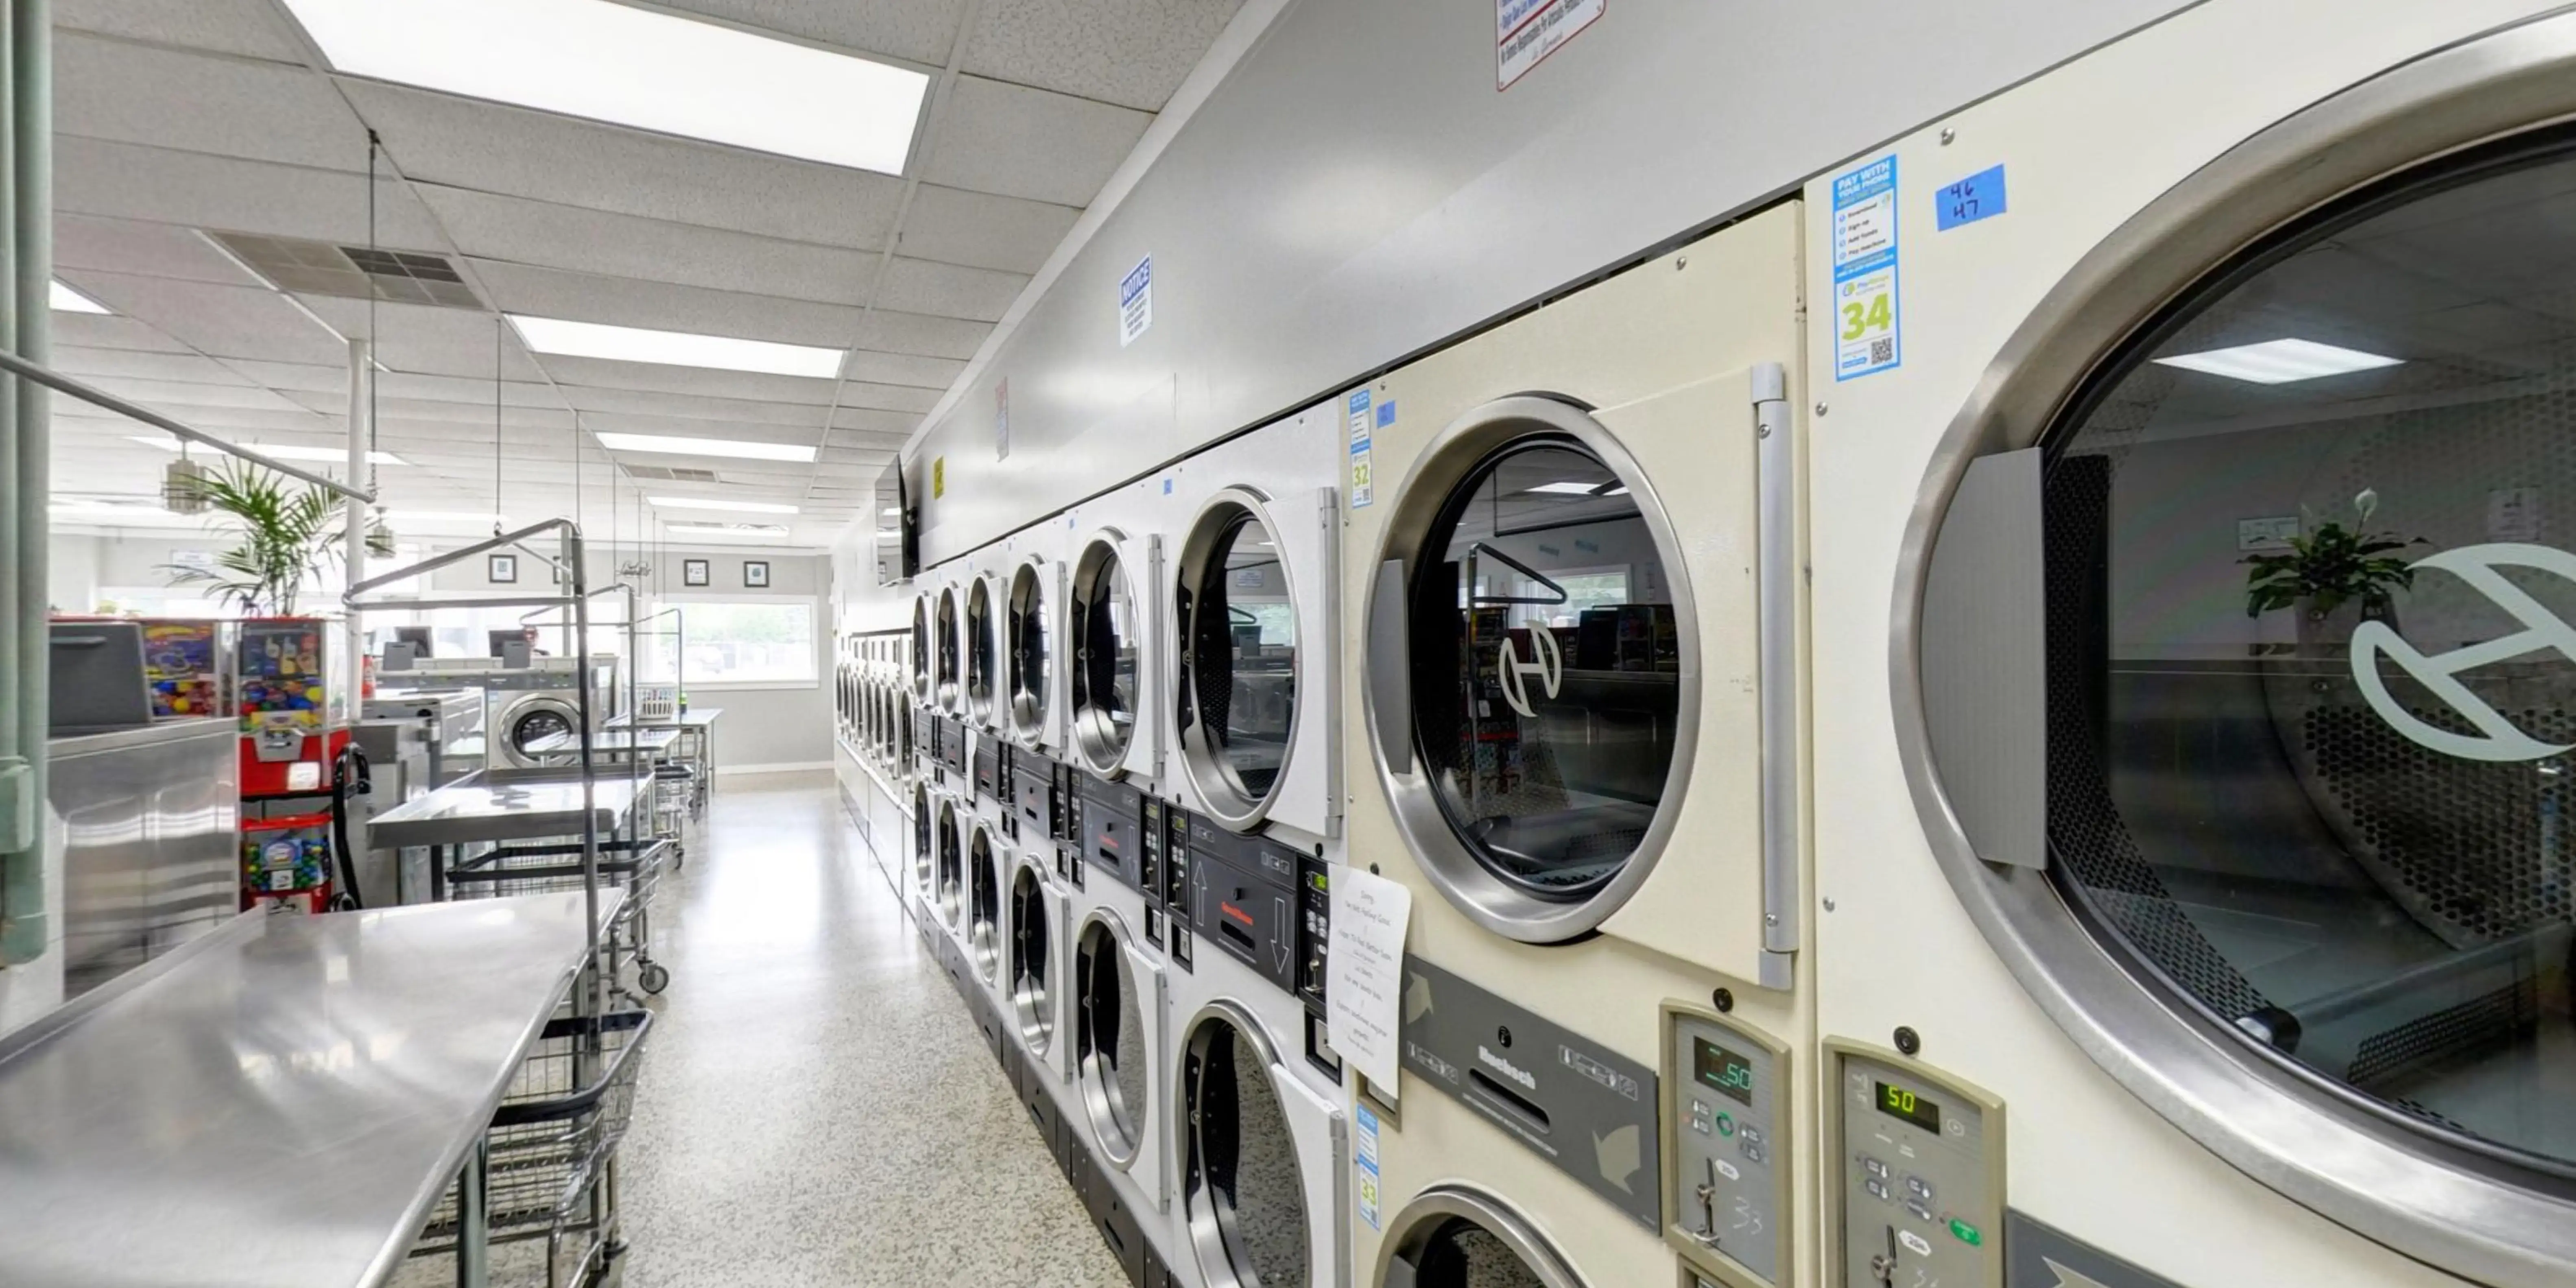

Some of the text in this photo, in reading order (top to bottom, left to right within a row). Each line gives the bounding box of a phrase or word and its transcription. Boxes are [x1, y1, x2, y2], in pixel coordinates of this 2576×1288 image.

[1838, 160, 1890, 192] PAY WITH
[1951, 182, 1974, 199] 46
[1954, 199, 1978, 219] 47
[1842, 293, 1891, 340] 34
[1354, 464, 1369, 487] 32
[1478, 1045, 1536, 1090] Huebsch
[1888, 1085, 1915, 1113] 50
